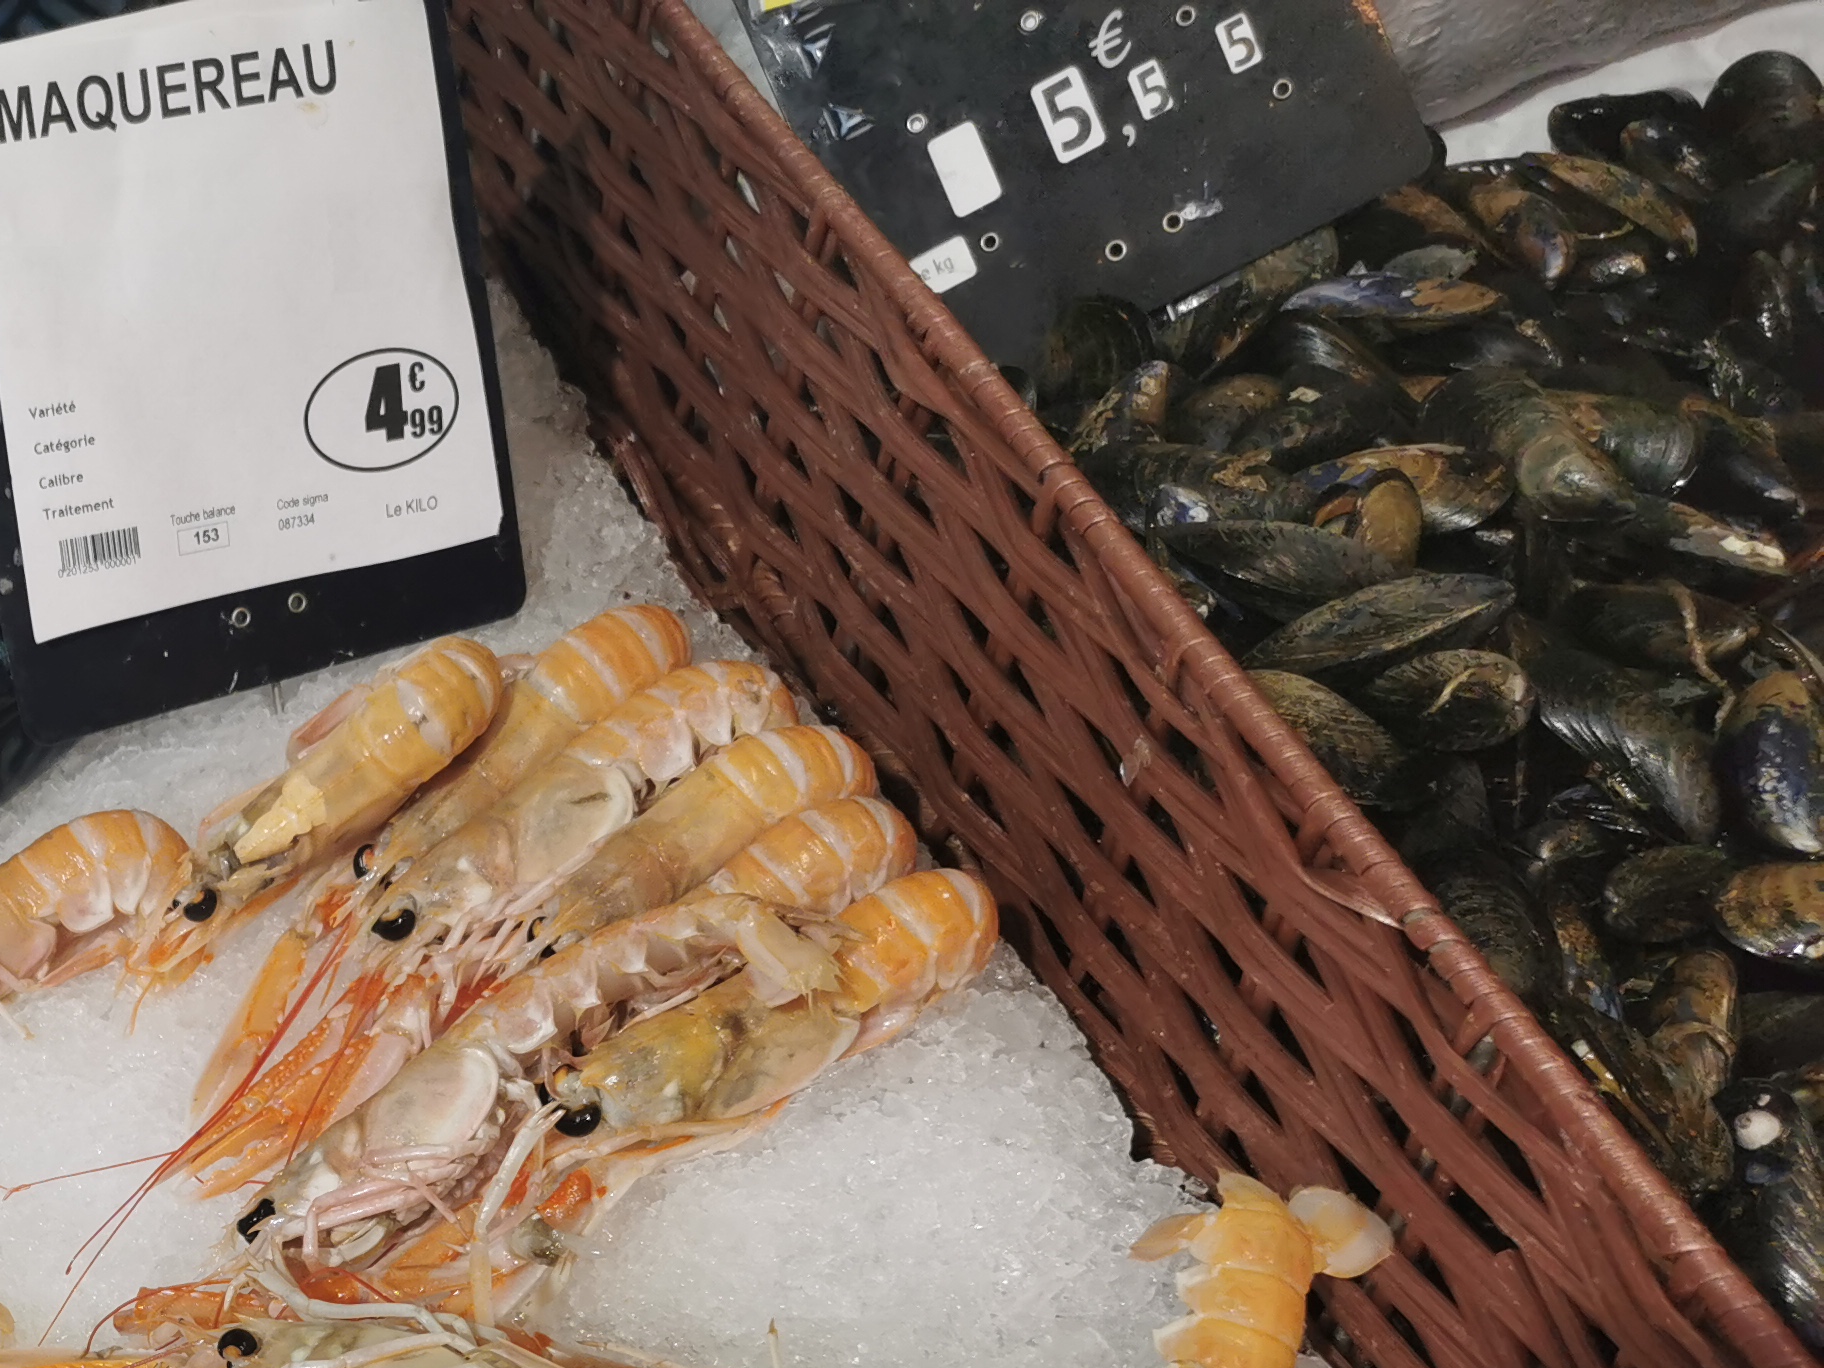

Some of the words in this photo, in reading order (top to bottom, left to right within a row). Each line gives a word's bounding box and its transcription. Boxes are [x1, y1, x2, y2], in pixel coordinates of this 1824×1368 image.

[29, 401, 76, 420] Variété
[410, 405, 443, 438] 99
[34, 434, 96, 455] Catégorie
[39, 472, 84, 489] Calibre
[43, 498, 114, 521] Traitement
[277, 497, 299, 511] Code
[303, 493, 328, 508] sigma
[386, 503, 402, 518] Le
[406, 496, 438, 515] KILO
[170, 509, 201, 526] Touche
[203, 505, 236, 521] balance
[278, 513, 315, 531] 087334
[194, 528, 220, 546] 153
